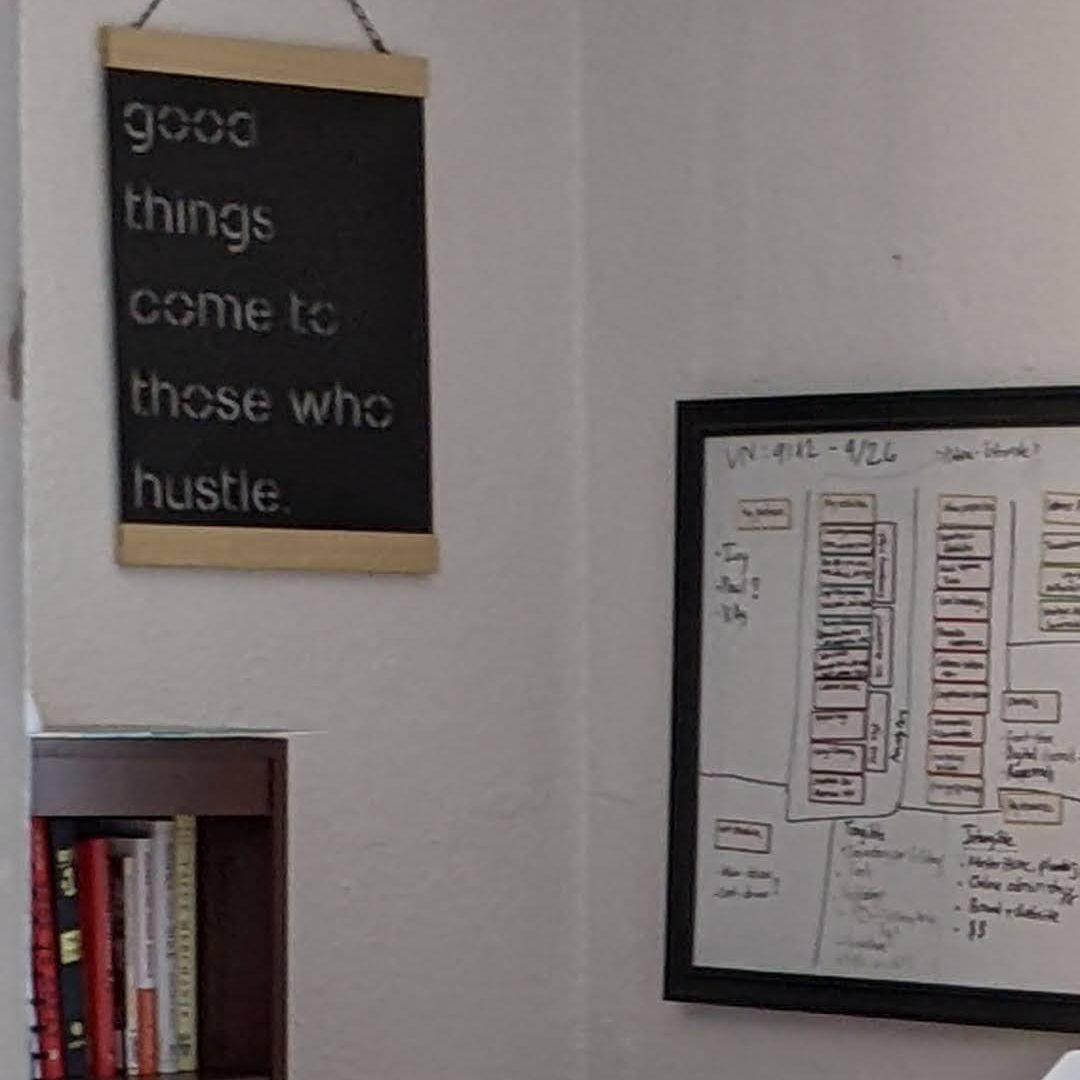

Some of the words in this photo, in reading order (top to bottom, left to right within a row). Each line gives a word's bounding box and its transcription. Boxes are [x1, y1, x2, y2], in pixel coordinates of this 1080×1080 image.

[123, 100, 258, 154] good
[124, 183, 277, 254] things
[128, 287, 274, 335] come
[288, 292, 342, 337] to
[129, 369, 273, 424] those
[290, 382, 395, 431] who
[131, 462, 293, 515] hustle.
